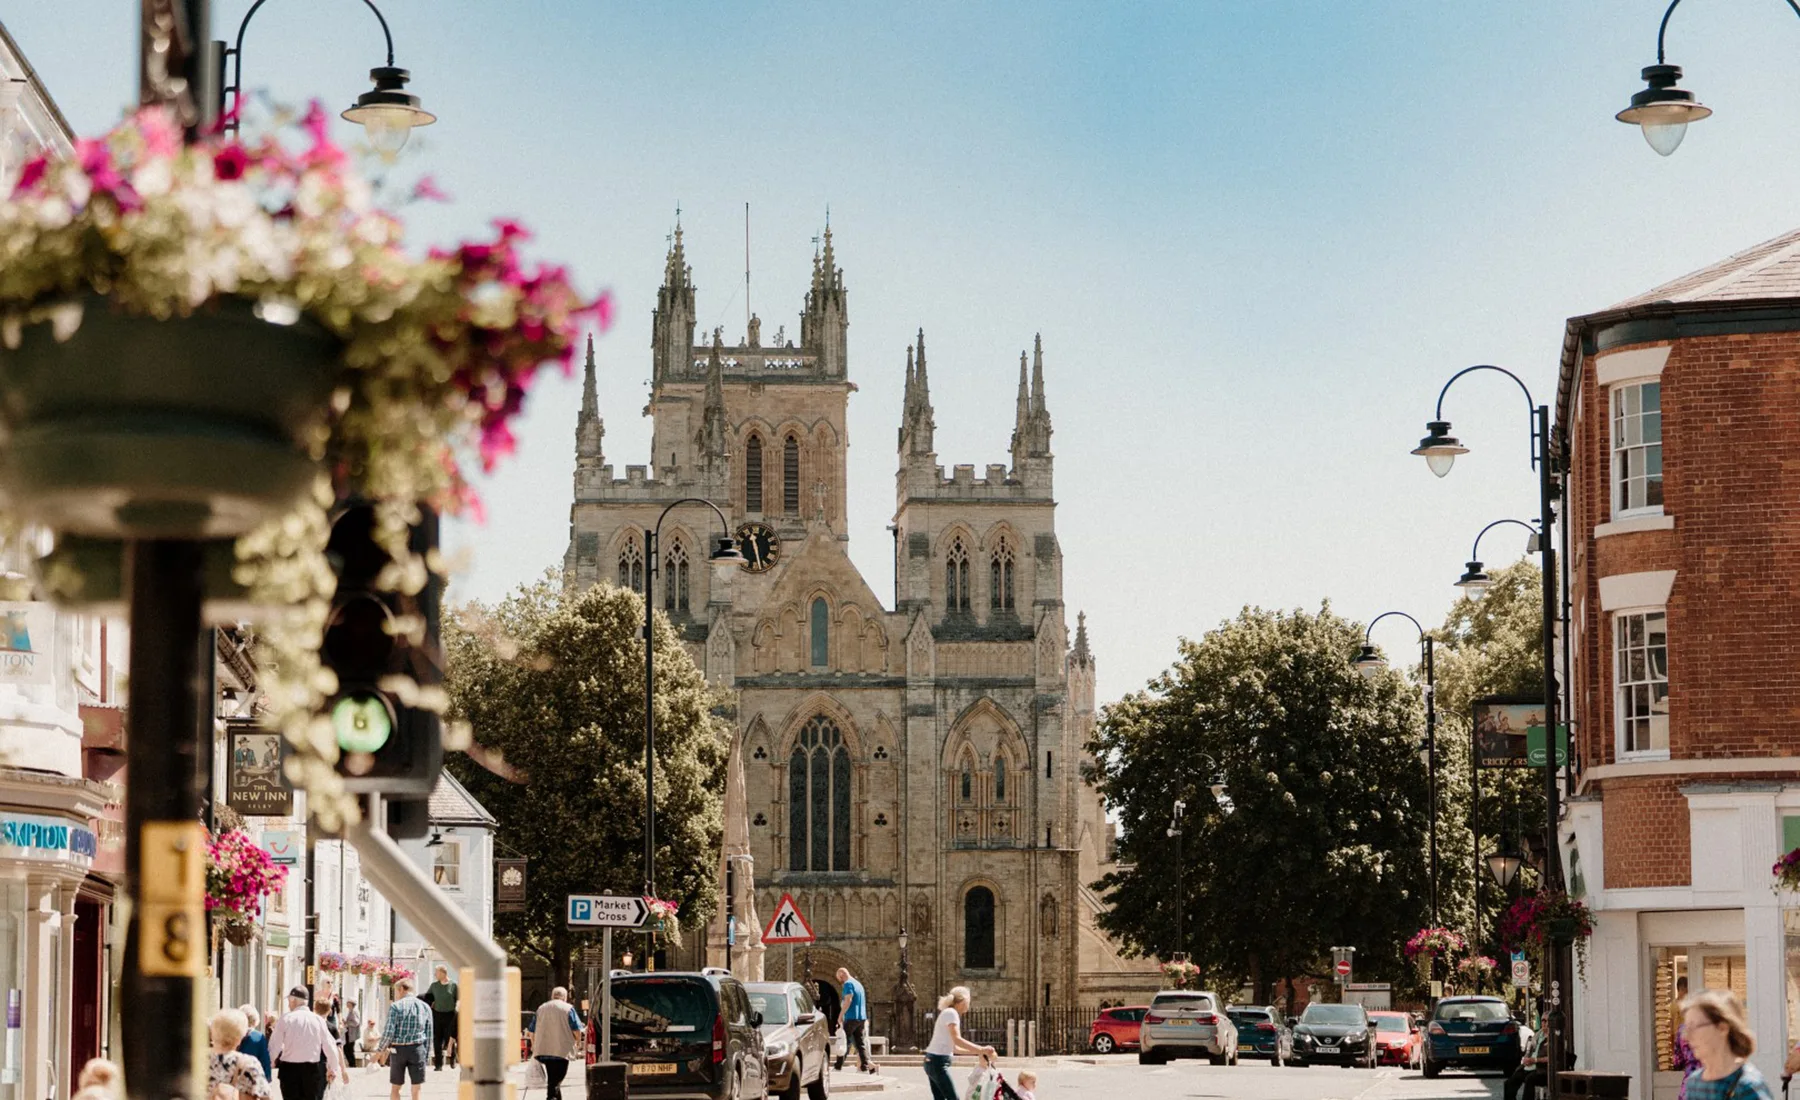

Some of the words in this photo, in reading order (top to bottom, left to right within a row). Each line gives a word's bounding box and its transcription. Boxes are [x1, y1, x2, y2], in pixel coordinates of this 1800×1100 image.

[1481, 757, 1528, 767] CRICKEERS
[233, 791, 260, 801] NEW
[264, 791, 287, 801] INN
[4, 820, 68, 850] SKIPTON
[594, 899, 631, 911] Market
[597, 911, 628, 921] Cross
